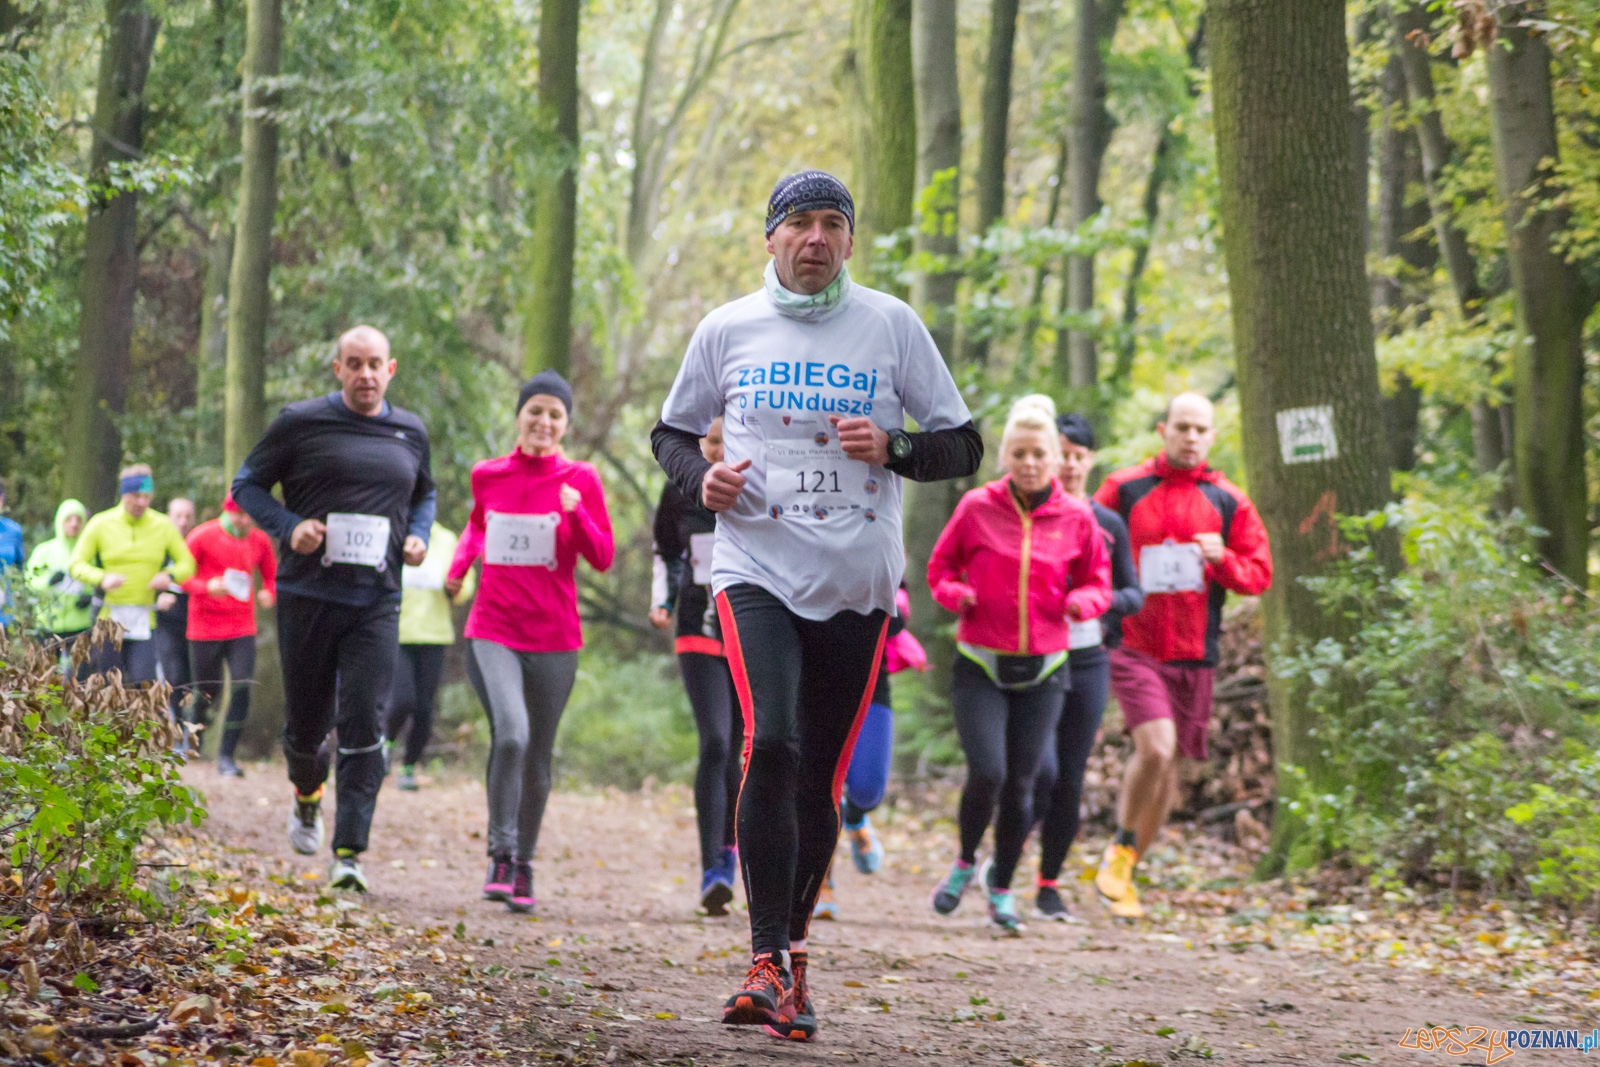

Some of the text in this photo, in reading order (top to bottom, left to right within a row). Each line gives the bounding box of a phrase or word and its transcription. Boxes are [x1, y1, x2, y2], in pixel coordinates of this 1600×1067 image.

[738, 361, 877, 398] zaBIEGaj
[754, 390, 873, 416] FUNdusze
[796, 470, 842, 493] 121
[345, 530, 374, 548] 102
[510, 534, 531, 551] 23
[1162, 560, 1181, 576] 14
